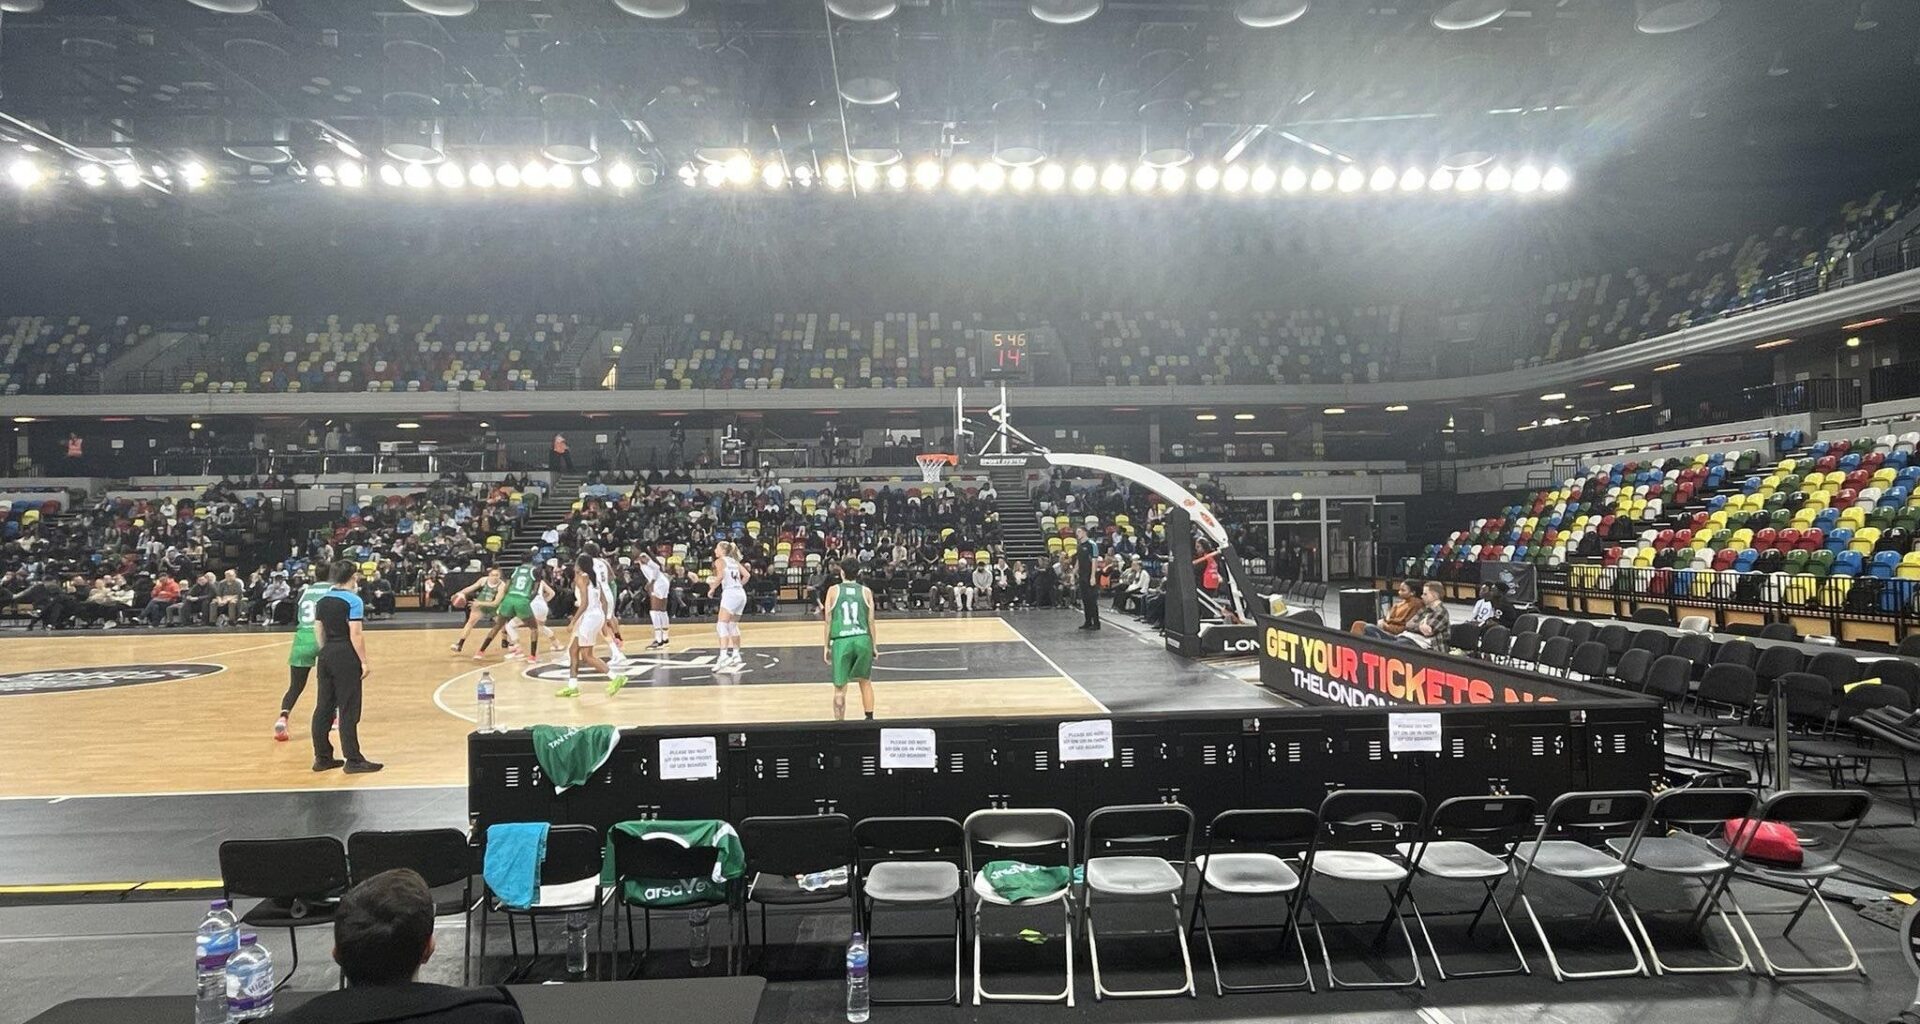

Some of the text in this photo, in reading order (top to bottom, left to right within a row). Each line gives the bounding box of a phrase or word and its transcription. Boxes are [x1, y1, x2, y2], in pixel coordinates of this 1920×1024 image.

[999, 349, 1020, 367] 14
[980, 458, 1027, 466] SPORT SYSTEM
[301, 600, 316, 623] 3
[841, 600, 859, 625] 11
[1265, 627, 1494, 706] GET YOUR TICKETS
